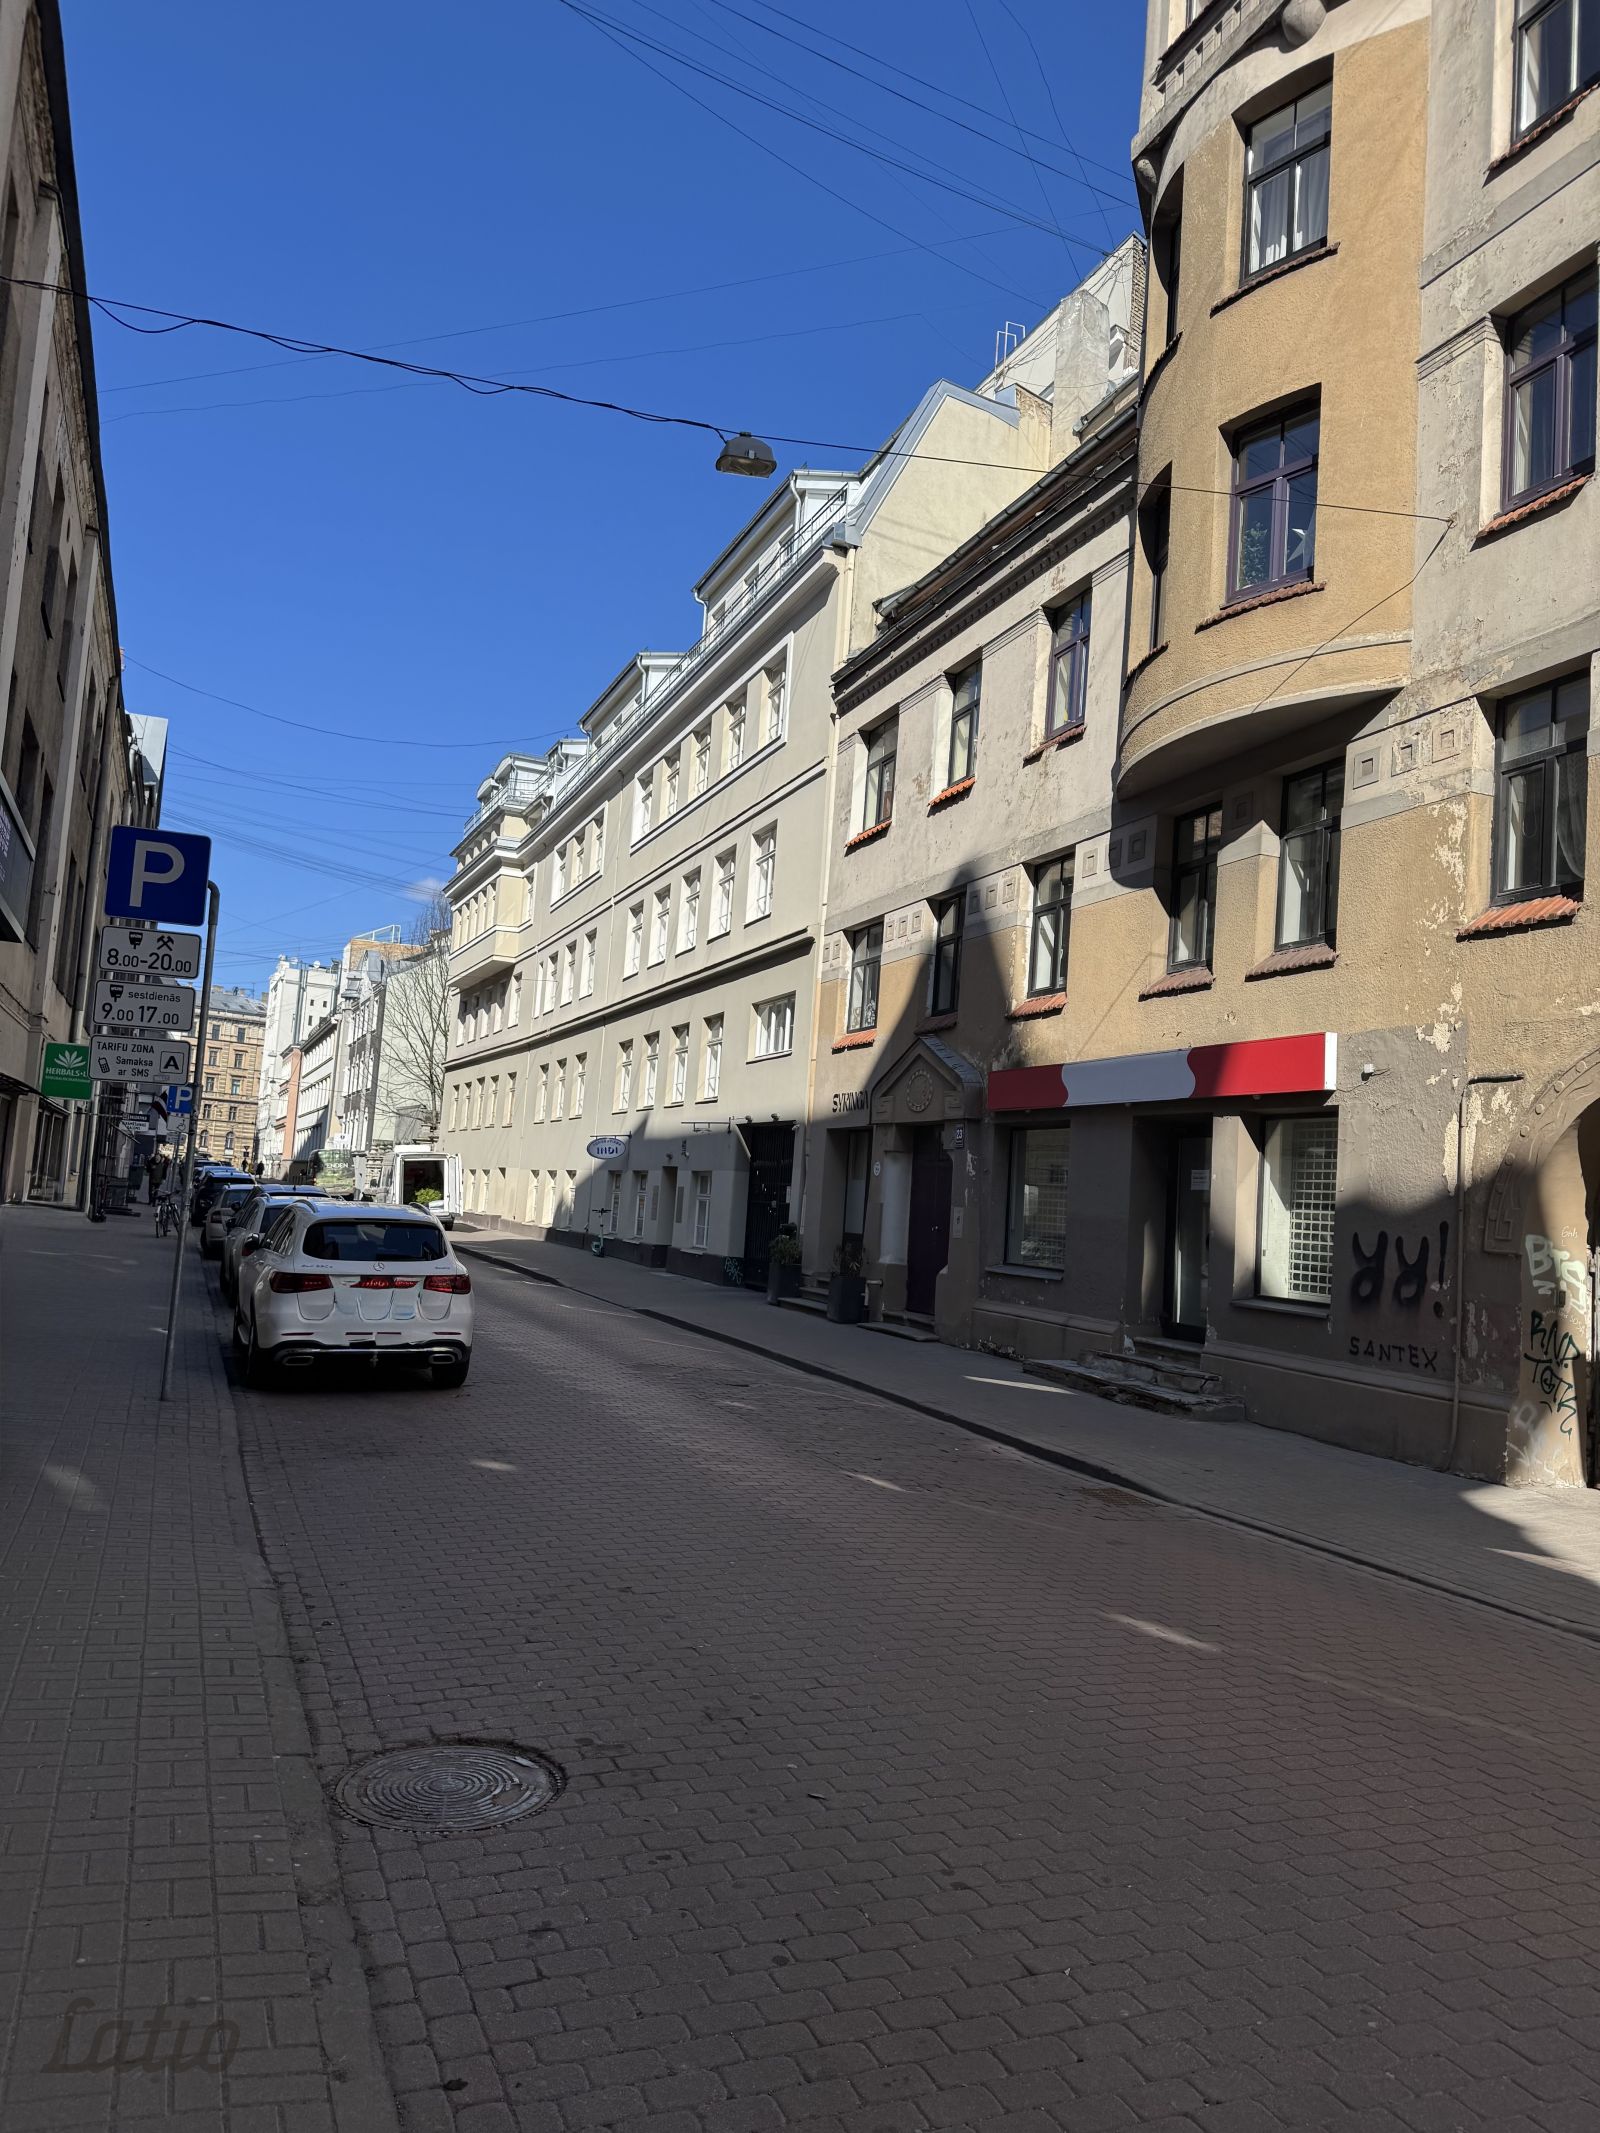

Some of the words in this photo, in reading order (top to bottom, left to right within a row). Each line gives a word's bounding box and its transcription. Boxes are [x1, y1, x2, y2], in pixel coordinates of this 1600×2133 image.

[129, 839, 186, 908] P
[128, 990, 181, 1004] sestdienās
[97, 1041, 128, 1052] TARIFU
[131, 1044, 155, 1054] ZONA
[116, 1056, 153, 1067] Samaksa
[164, 1056, 179, 1070] A
[131, 1068, 150, 1077] SMS
[175, 1086, 192, 1109] P
[832, 1090, 869, 1113] SYRINGA
[597, 1146, 618, 1155] INDI
[1349, 1337, 1438, 1373] SANTEX
